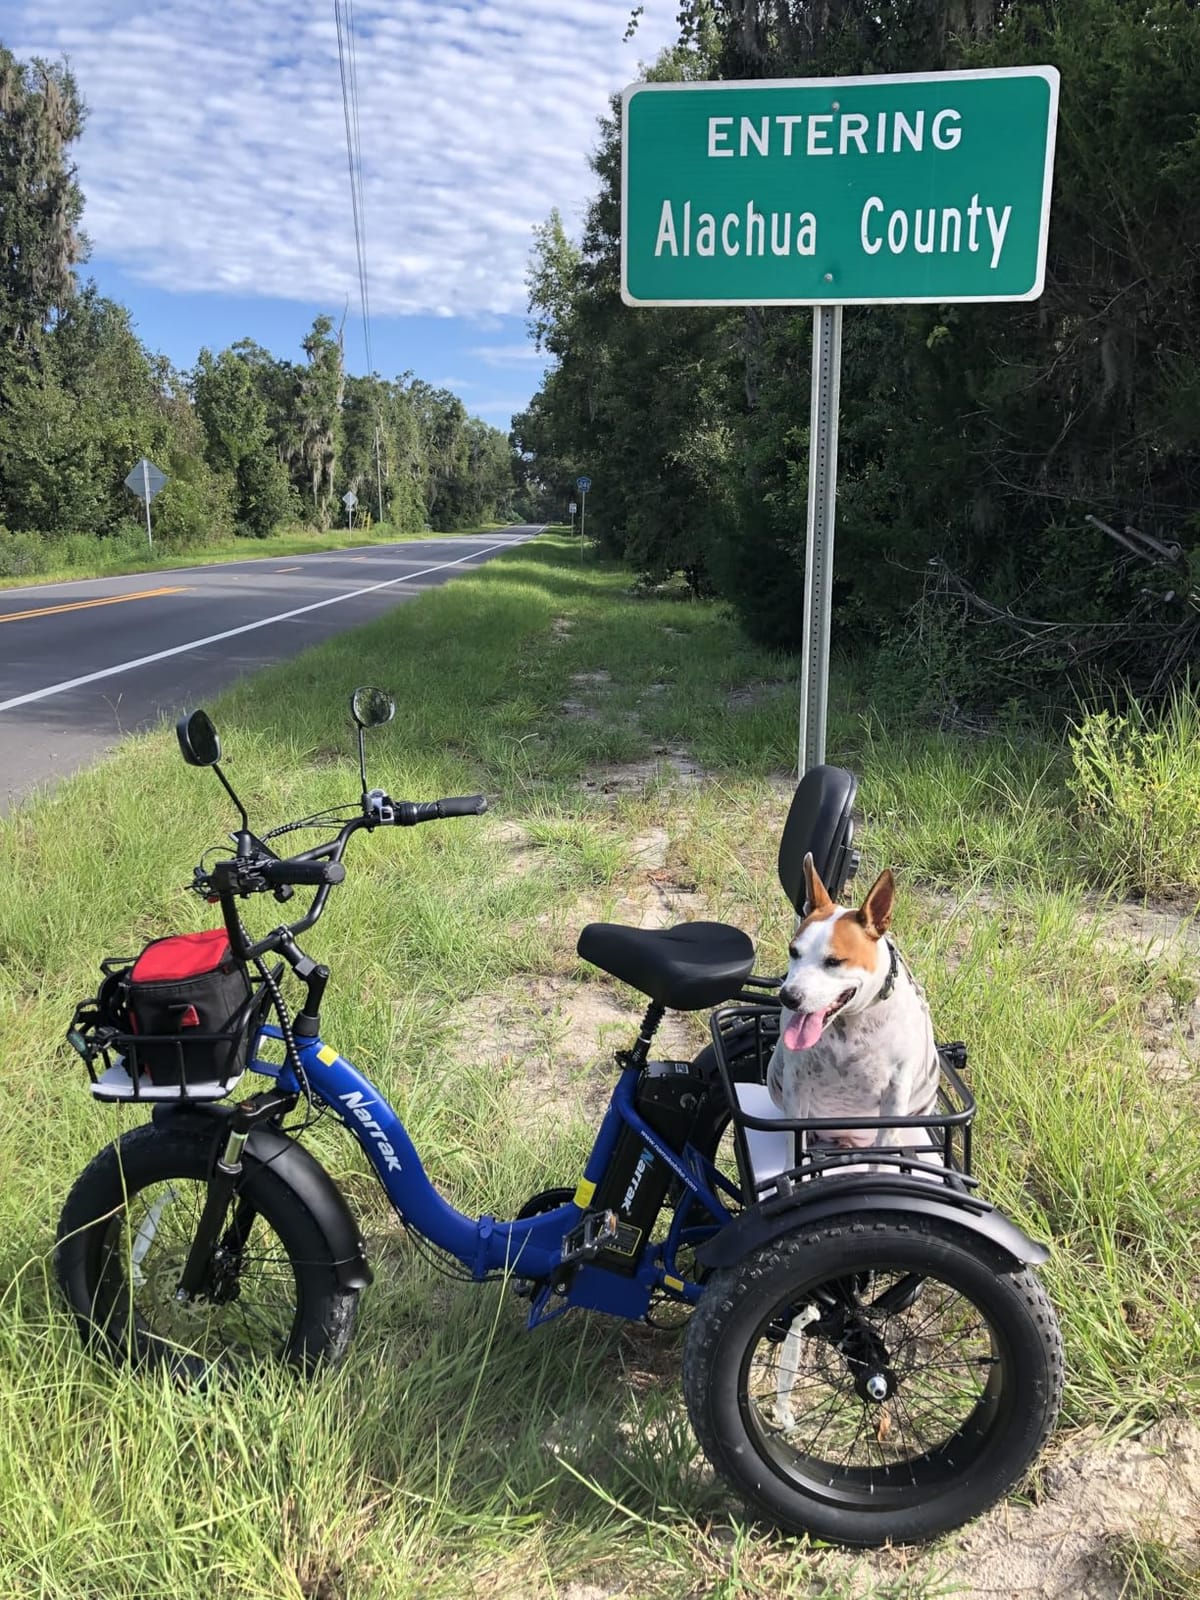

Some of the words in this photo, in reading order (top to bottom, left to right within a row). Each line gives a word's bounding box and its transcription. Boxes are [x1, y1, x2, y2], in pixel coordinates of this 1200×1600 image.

[707, 109, 963, 157] ENTERING
[654, 200, 817, 257] Alachua
[860, 193, 1012, 269] County
[338, 1090, 403, 1173] Narrak
[621, 1147, 655, 1212] Narrak
